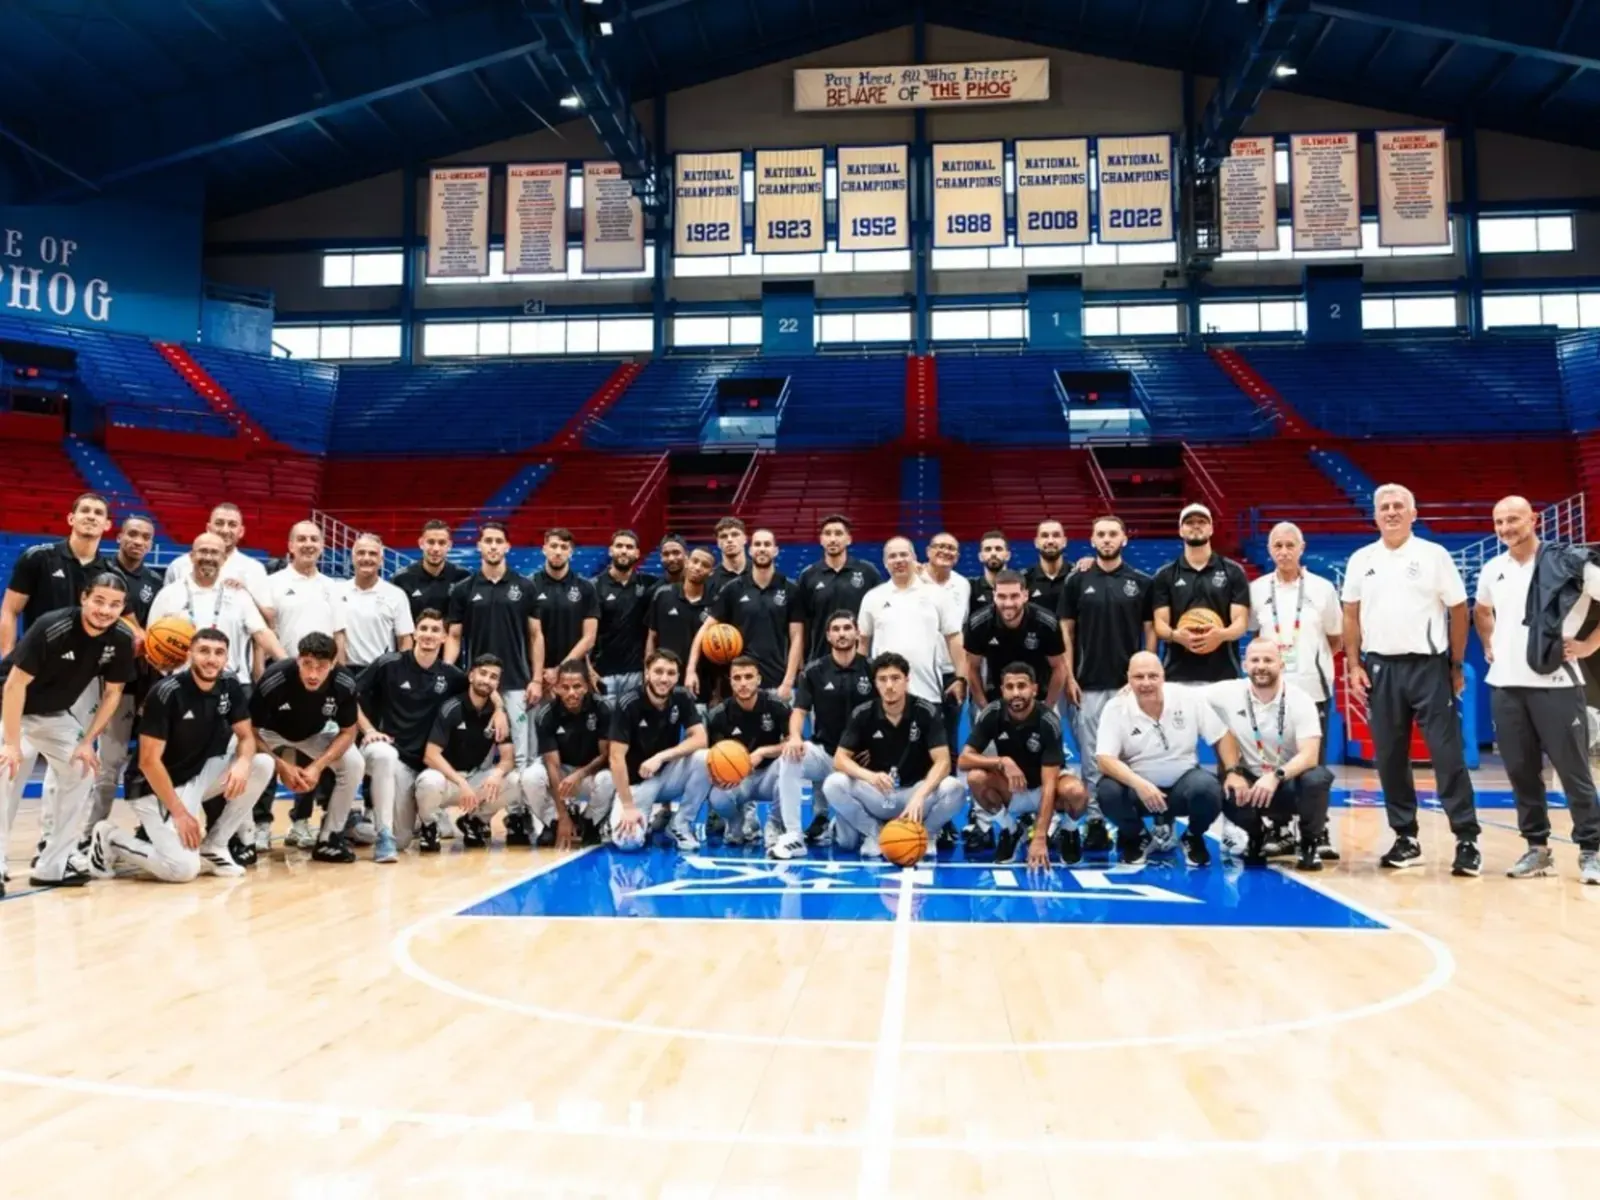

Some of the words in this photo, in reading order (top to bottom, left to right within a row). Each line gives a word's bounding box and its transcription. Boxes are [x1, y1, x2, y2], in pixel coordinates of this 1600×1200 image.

[826, 86, 888, 107] BEWARE
[898, 85, 920, 102] OF
[1301, 136, 1348, 146] OLYMPIANS
[942, 159, 996, 172] NATIONAL
[1025, 157, 1080, 169] NATIONAL
[1107, 153, 1163, 166] NATIONAL
[683, 169, 734, 181] NATIONAL
[764, 166, 816, 178] NATIONAL
[847, 163, 900, 175] NATIONAL
[1101, 169, 1169, 183] CHAMPIONS
[841, 180, 906, 192] CHAMPIONS
[935, 176, 1002, 189] CHAMPIONS
[1018, 173, 1086, 187] CHAMPIONS
[676, 186, 739, 198] CHAMPIONS
[758, 182, 822, 195] CHAMPIONS
[947, 213, 992, 234] 1988
[1027, 210, 1078, 230] 2008
[1109, 208, 1162, 228] 2022
[686, 222, 730, 242] 1922
[767, 219, 812, 239] 1923
[851, 217, 897, 237] 1952
[40, 236, 78, 267] OF
[0, 264, 113, 322] HOG
[525, 298, 543, 313] 21
[1329, 303, 1341, 319] 2
[778, 318, 799, 333] 22
[1052, 311, 1060, 327] 1
